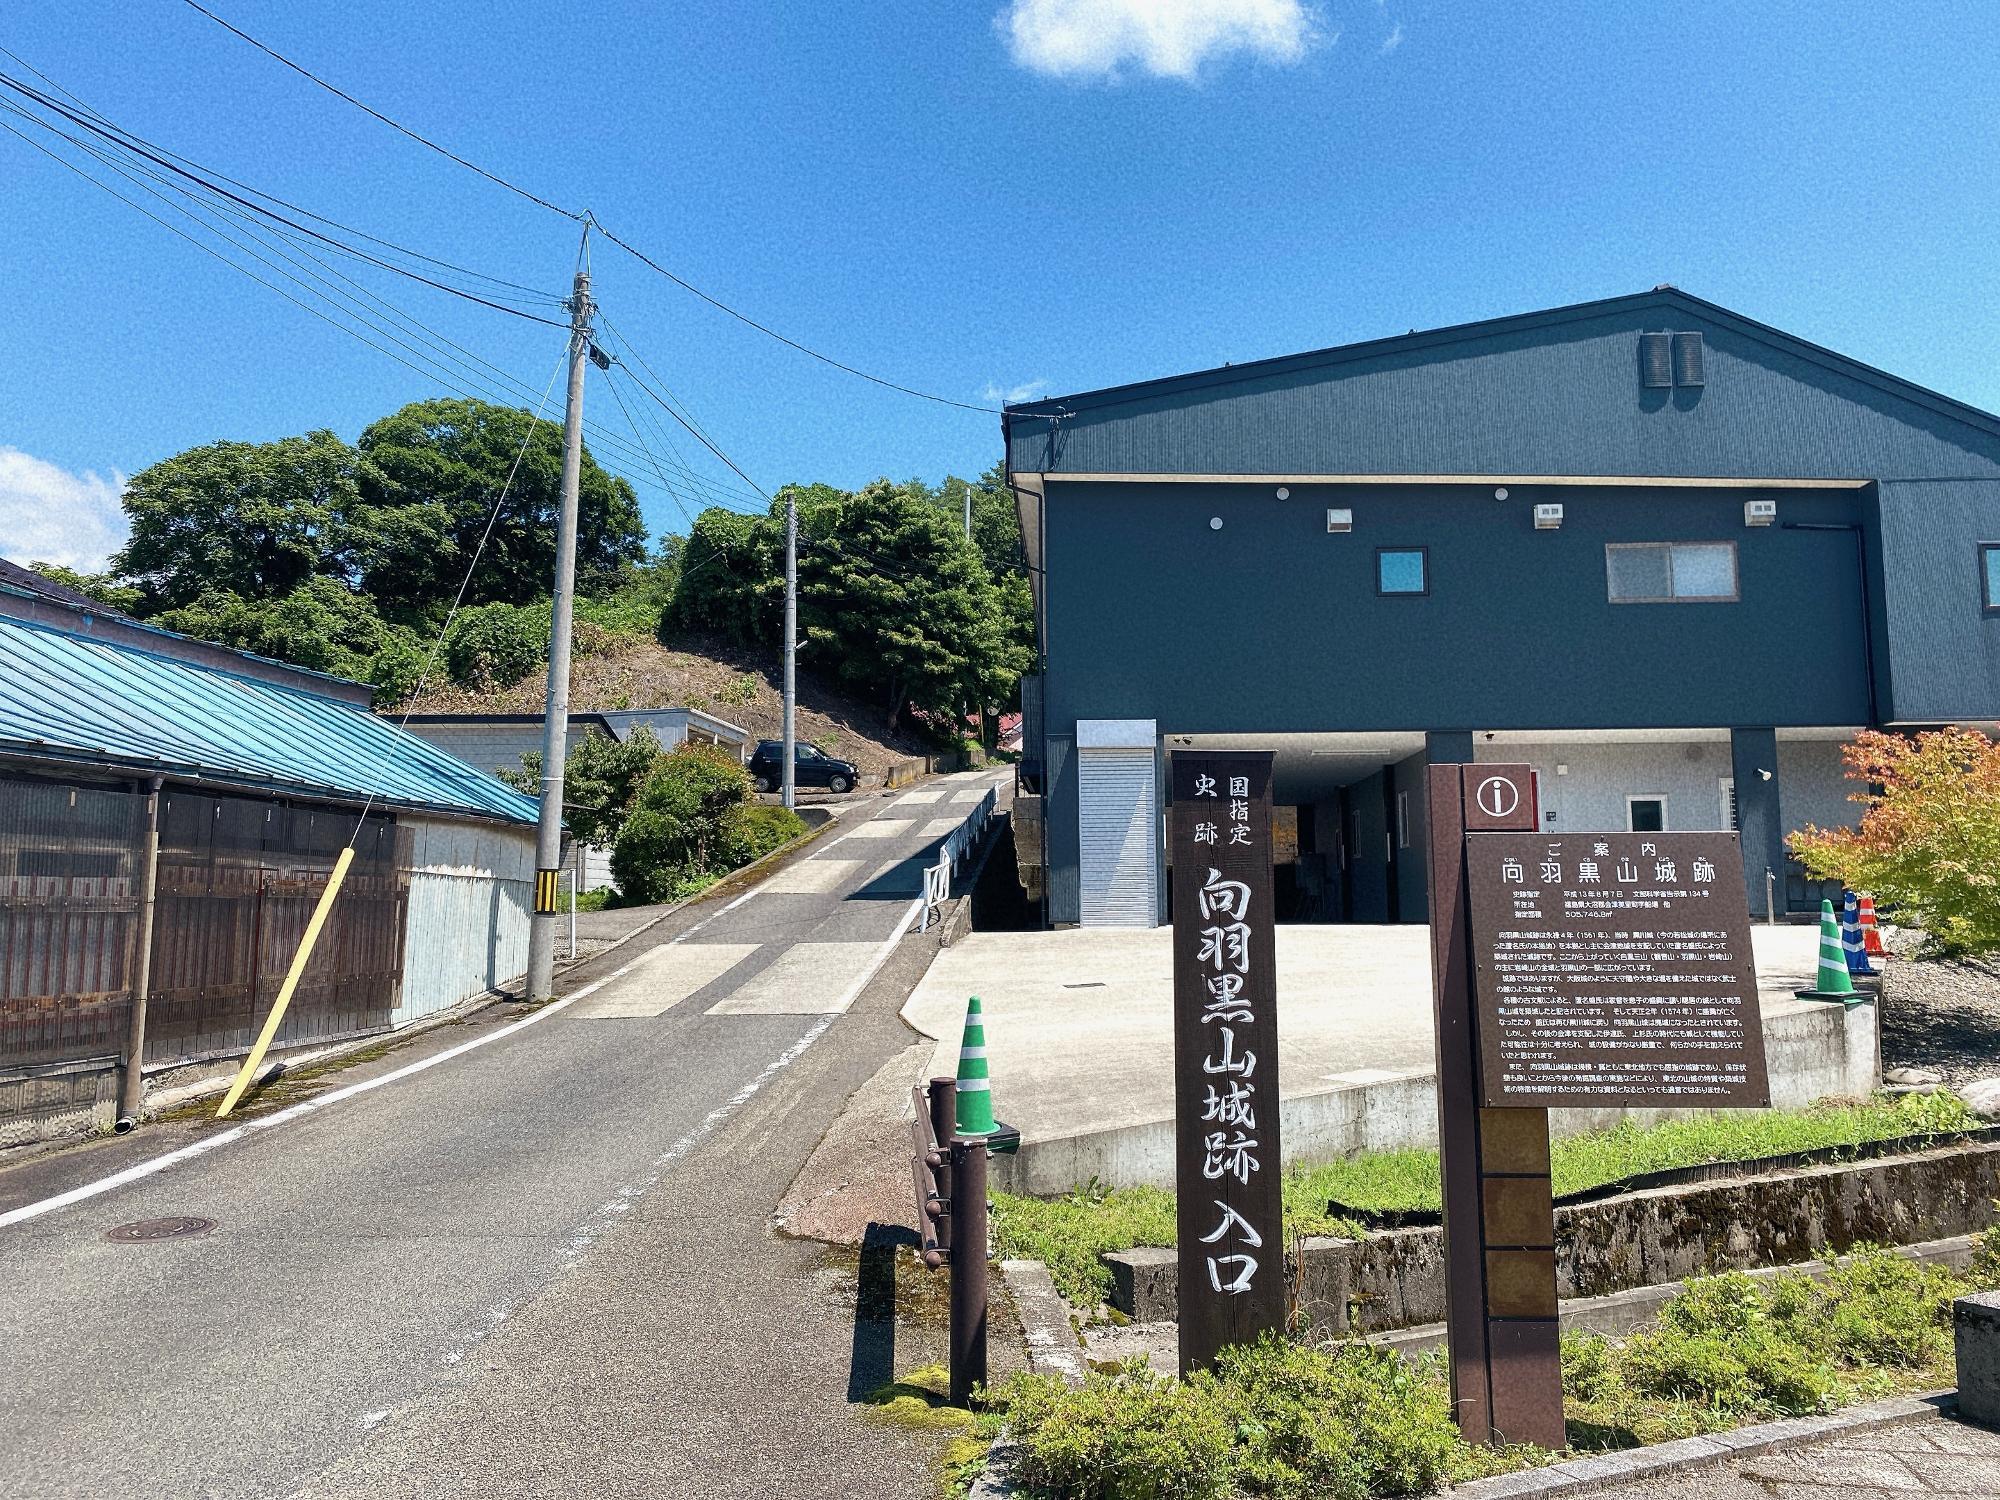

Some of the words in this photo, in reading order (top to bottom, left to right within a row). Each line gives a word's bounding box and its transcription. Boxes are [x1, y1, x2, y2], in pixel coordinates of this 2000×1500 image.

[1195, 774, 1218, 845] 史跡
[1229, 777, 1252, 845] 国指定
[1548, 841, 1657, 857] ご案内
[1503, 863, 1715, 883] 向羽黒山城跡
[1513, 900, 1535, 909] 所在地
